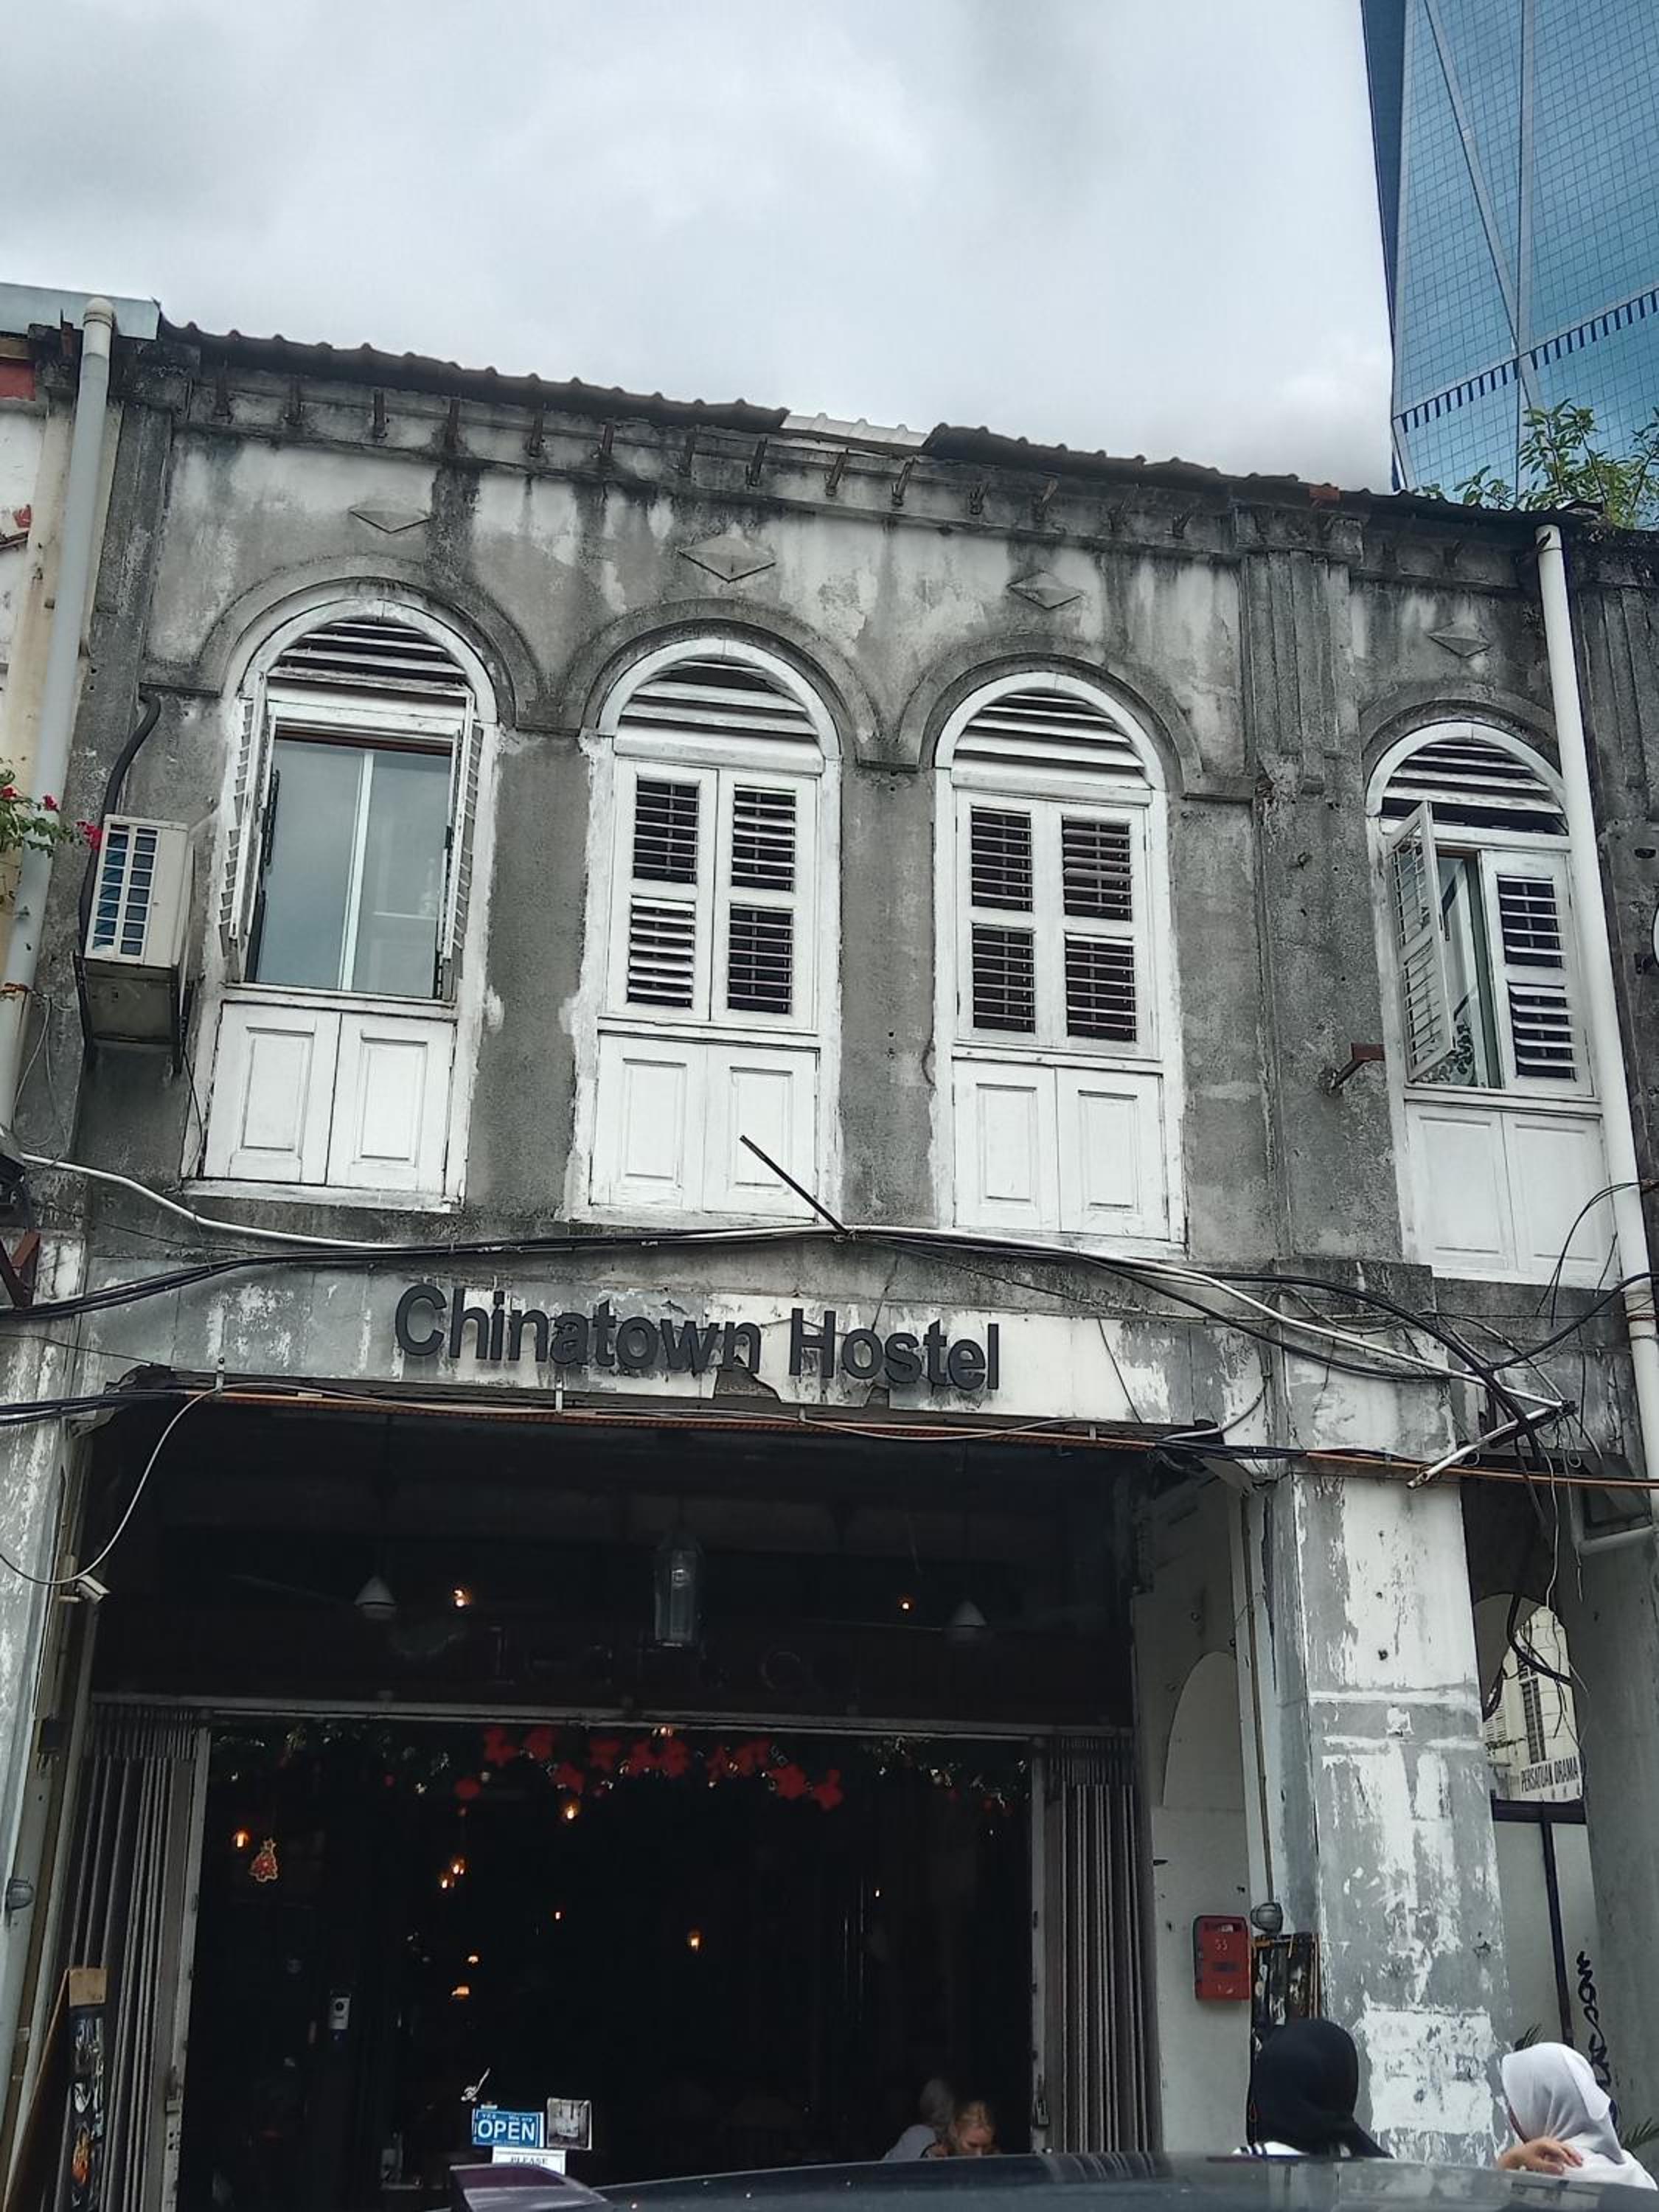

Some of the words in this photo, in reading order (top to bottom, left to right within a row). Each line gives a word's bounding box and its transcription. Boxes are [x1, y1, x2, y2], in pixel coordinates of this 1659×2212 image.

[394, 1284, 761, 1374] Chinatown
[788, 1308, 999, 1391] Hostel
[1554, 1756, 1579, 1784] DRAMA
[477, 2119, 535, 2141] OPEN
